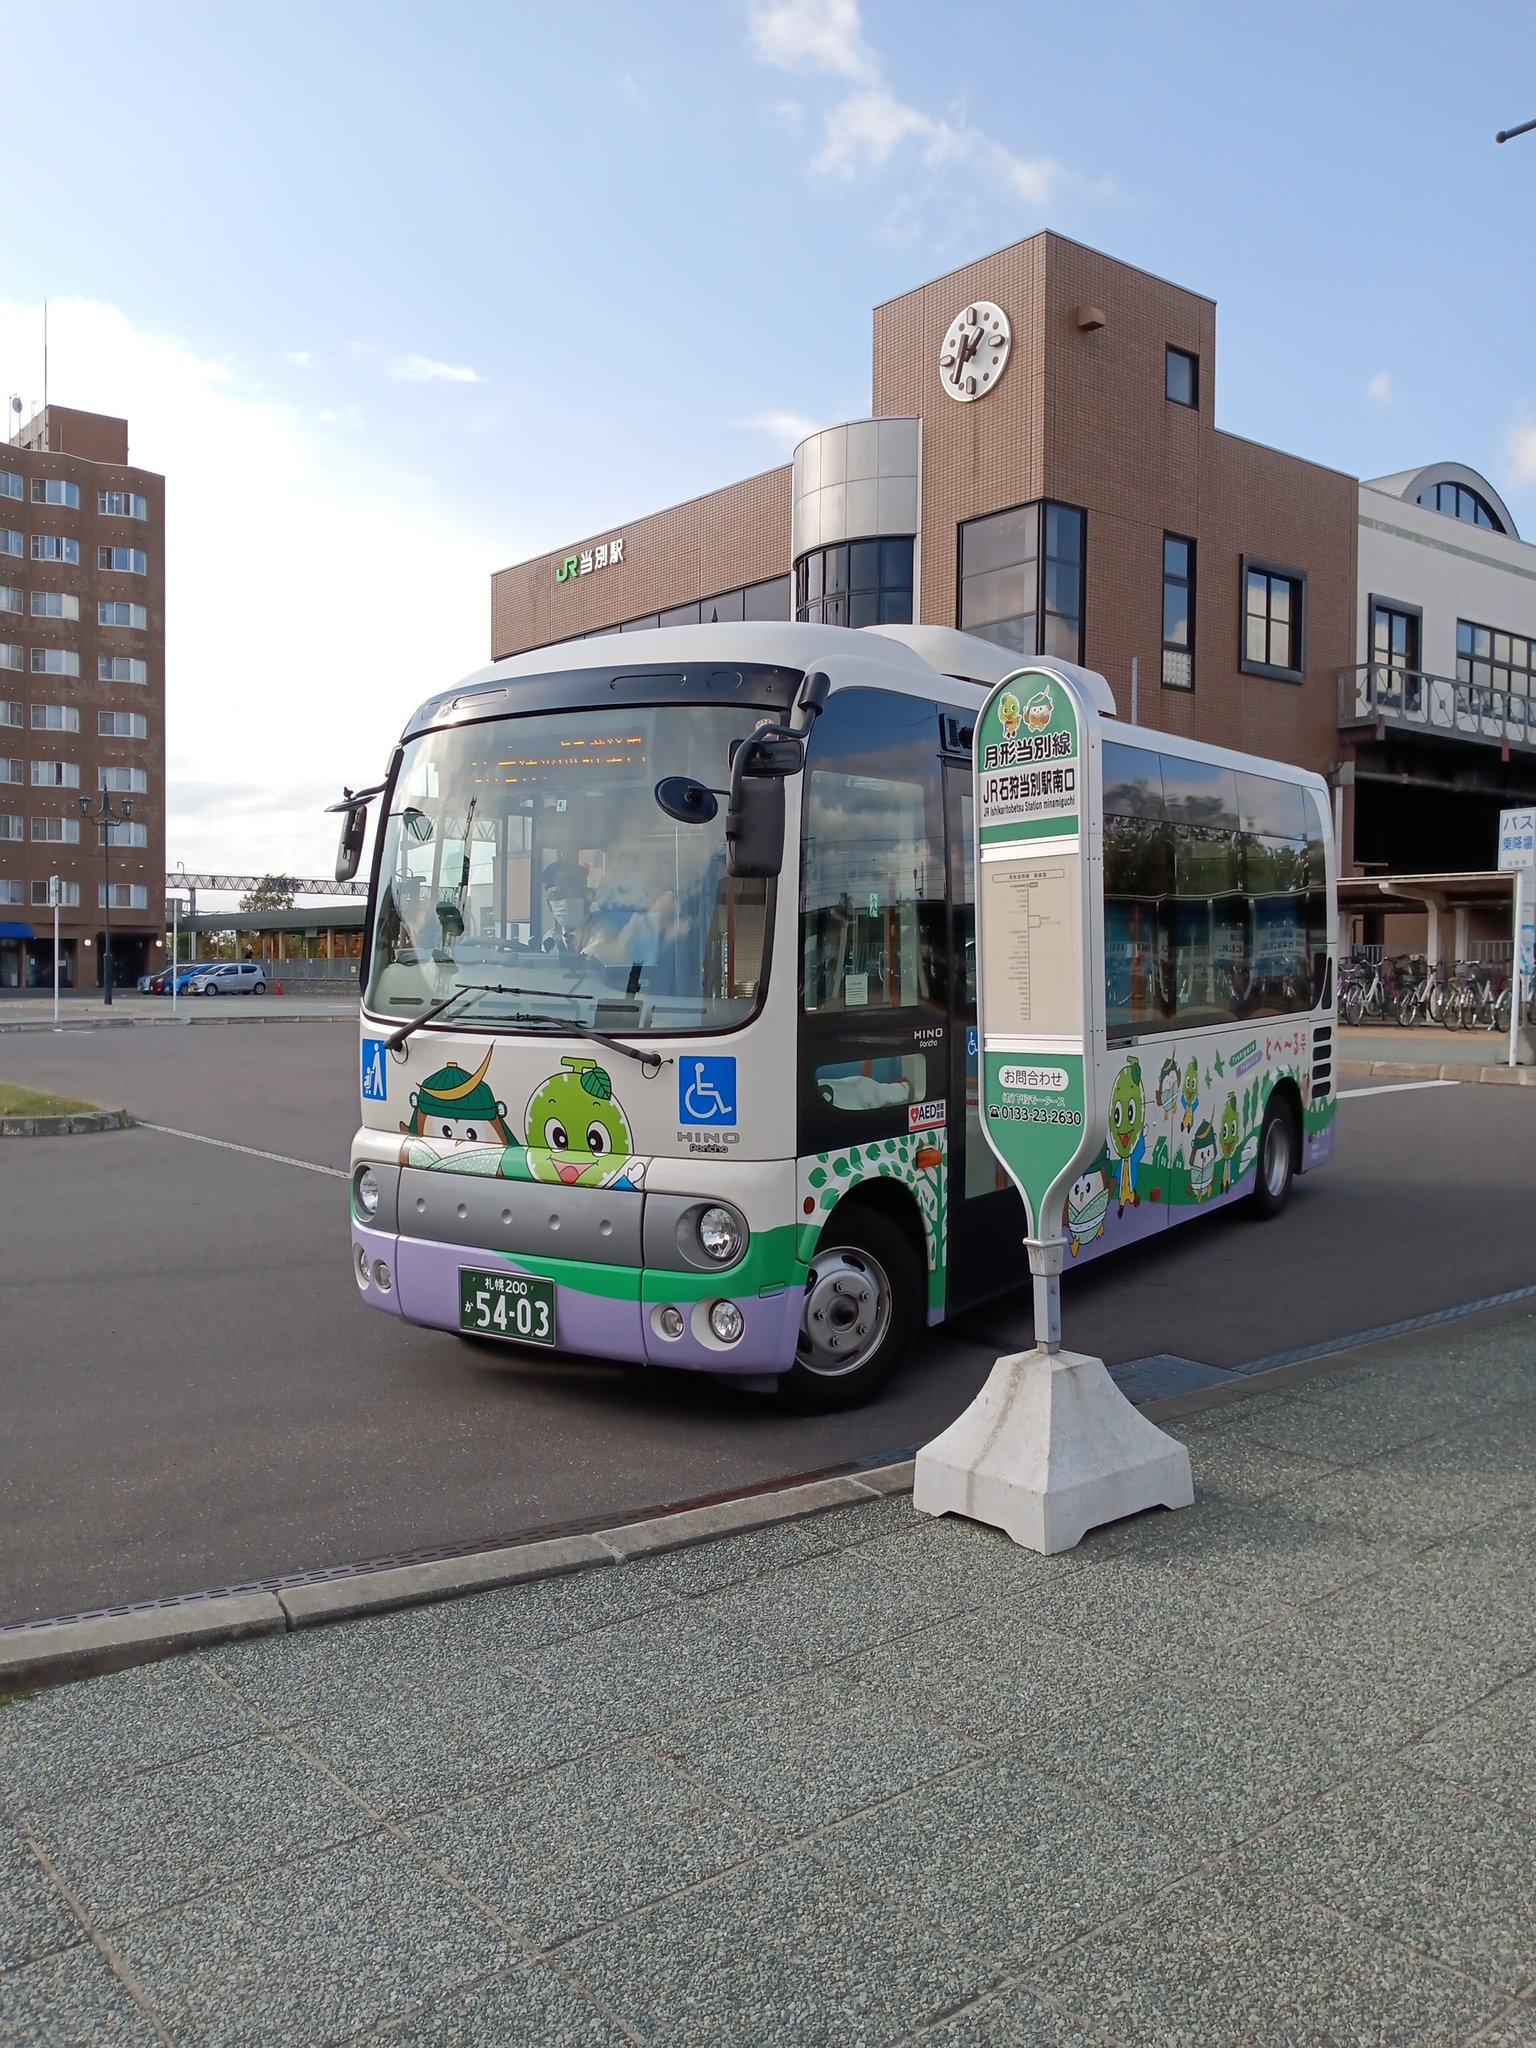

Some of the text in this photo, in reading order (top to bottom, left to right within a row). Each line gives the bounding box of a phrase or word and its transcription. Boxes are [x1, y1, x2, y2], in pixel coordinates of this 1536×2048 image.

[984, 731, 1071, 769] 月形当別線
[983, 768, 1075, 804] JR石狩当別駅南口
[983, 806, 989, 817] JR
[1025, 800, 1042, 811] Station
[1043, 795, 1075, 809] minamiguchi
[1503, 815, 1533, 831] バス
[1502, 836, 1533, 851] 乗降場
[914, 1027, 943, 1040] HINO
[1004, 1069, 1062, 1087] お問合わせ
[919, 1104, 937, 1120] AED
[1001, 1106, 1082, 1125] 0133-23-2630
[677, 1131, 740, 1144] HINO
[689, 1143, 729, 1153] Poncho
[476, 1291, 549, 1337] 54-03
